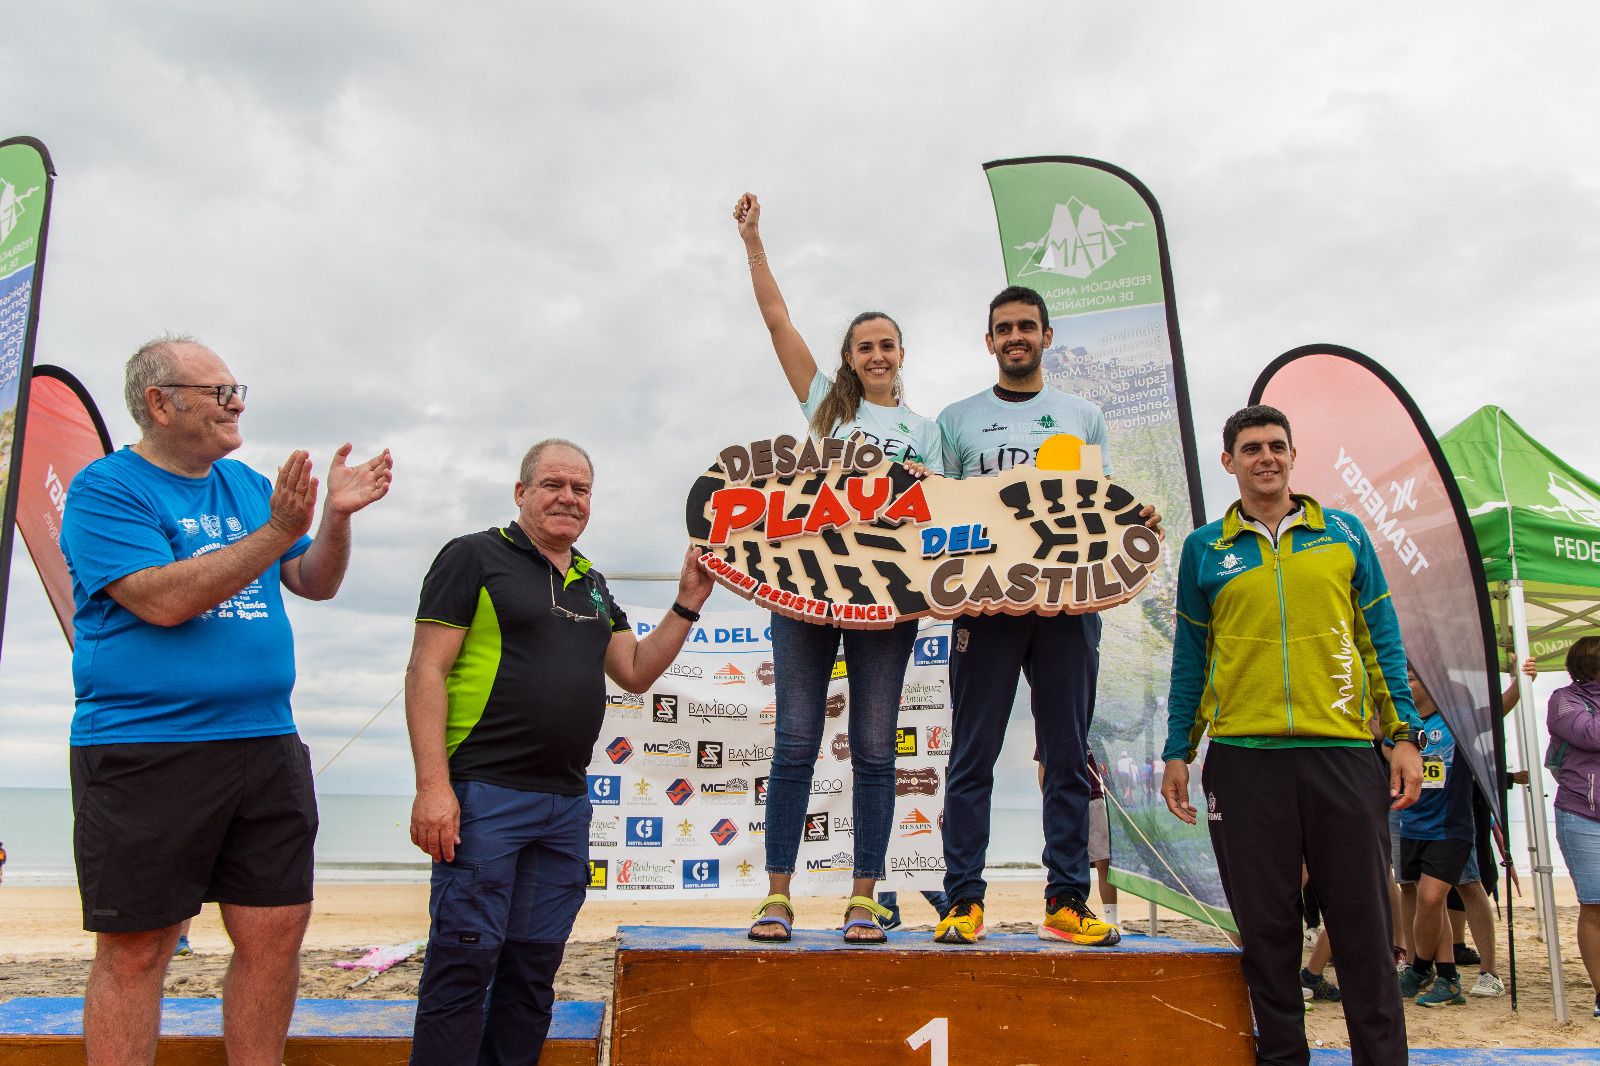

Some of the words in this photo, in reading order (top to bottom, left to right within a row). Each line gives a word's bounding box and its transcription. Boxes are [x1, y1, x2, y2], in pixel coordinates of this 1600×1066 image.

[719, 430, 884, 482] DESAFÍO
[980, 443, 1040, 474] LÍD
[709, 476, 933, 545] PLAYA
[921, 523, 990, 555] DEL
[1554, 535, 1600, 563] FEDE
[930, 526, 1161, 607] CASTILLO
[757, 582, 828, 615] RESISTE
[832, 603, 894, 621] VENCE!
[714, 627, 759, 644] DEL
[670, 663, 703, 676] BOO
[688, 702, 748, 717] BAMBOO
[728, 747, 774, 760] BAMBO
[811, 778, 843, 793] BOO
[904, 1017, 949, 1066] 1
